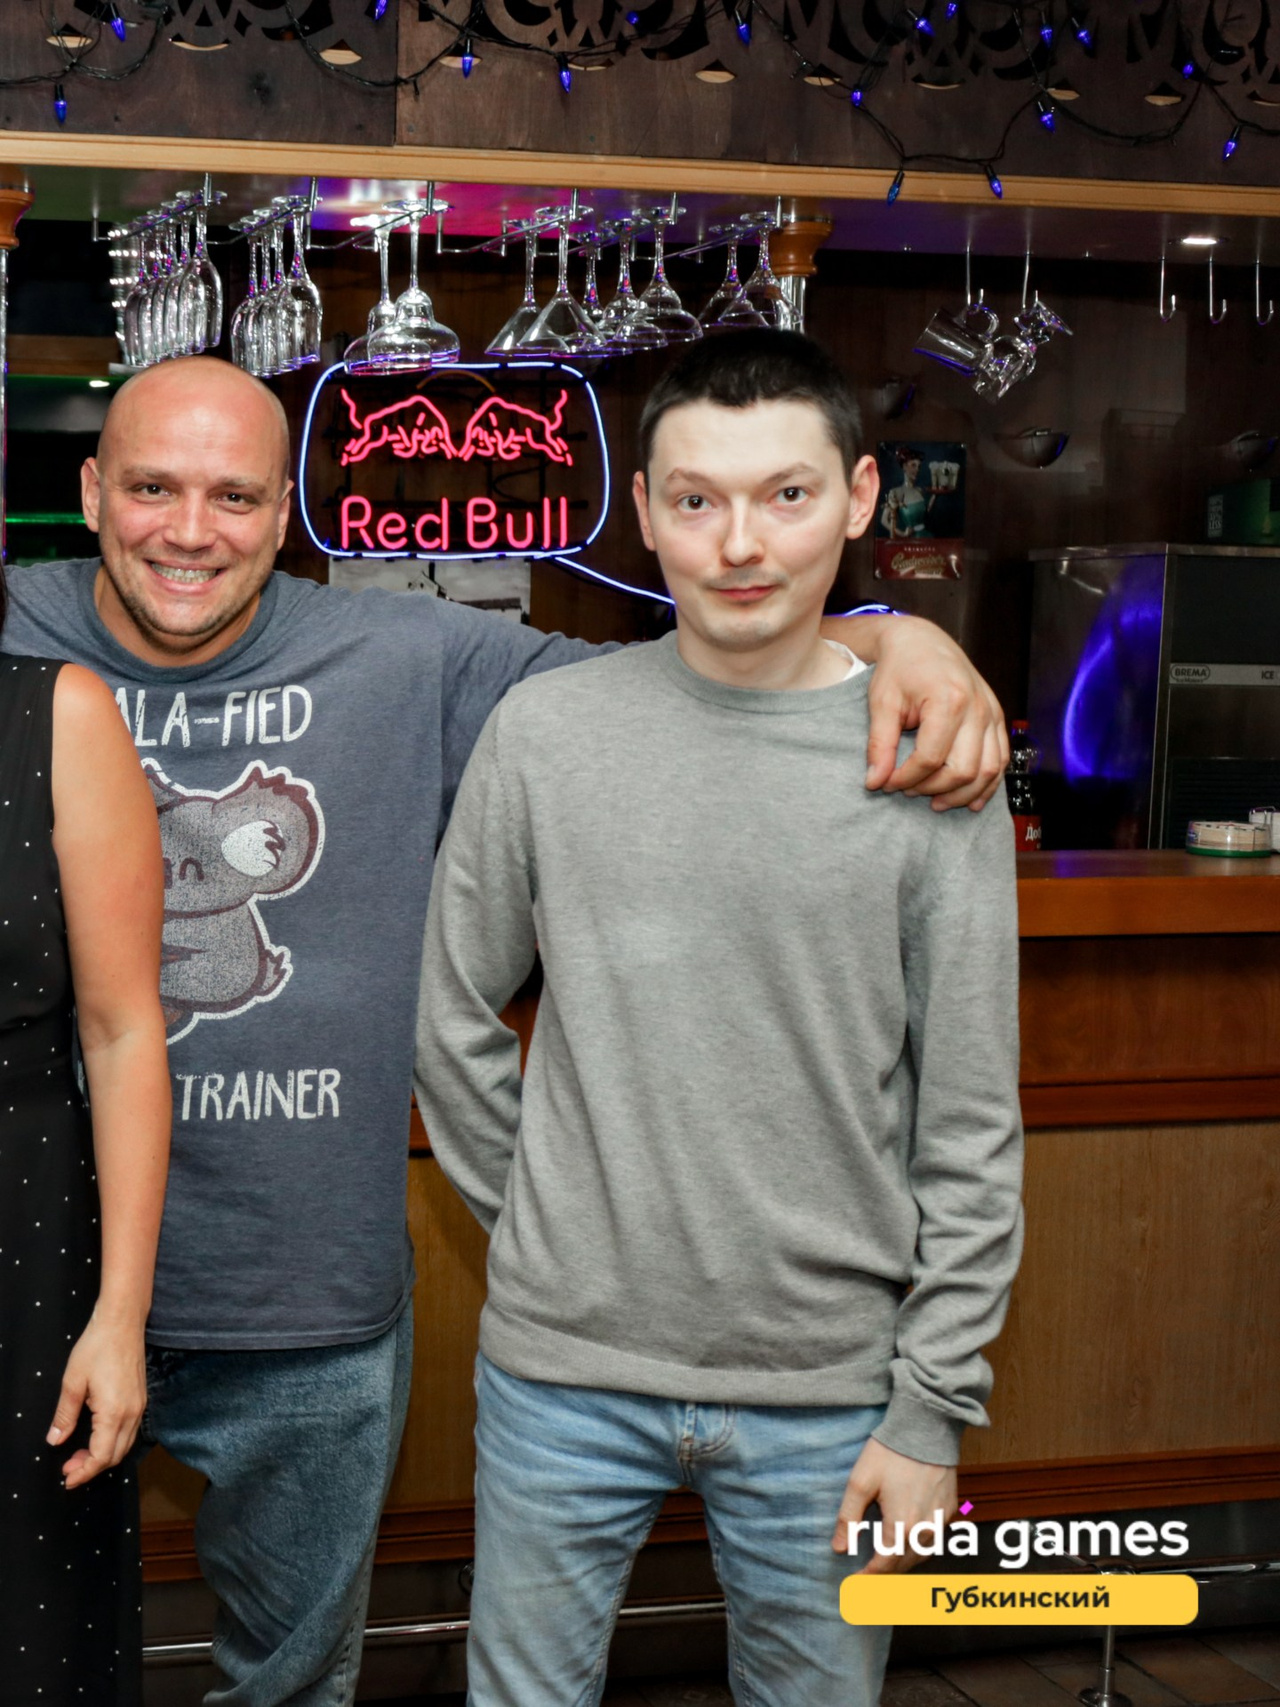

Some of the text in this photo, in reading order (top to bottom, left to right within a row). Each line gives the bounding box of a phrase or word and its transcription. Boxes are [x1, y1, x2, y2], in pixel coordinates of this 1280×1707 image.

[340, 495, 568, 551] Red Bull
[1174, 668, 1207, 677] BREMA
[1261, 671, 1274, 680] ICE
[176, 1068, 341, 1121] TRAINER
